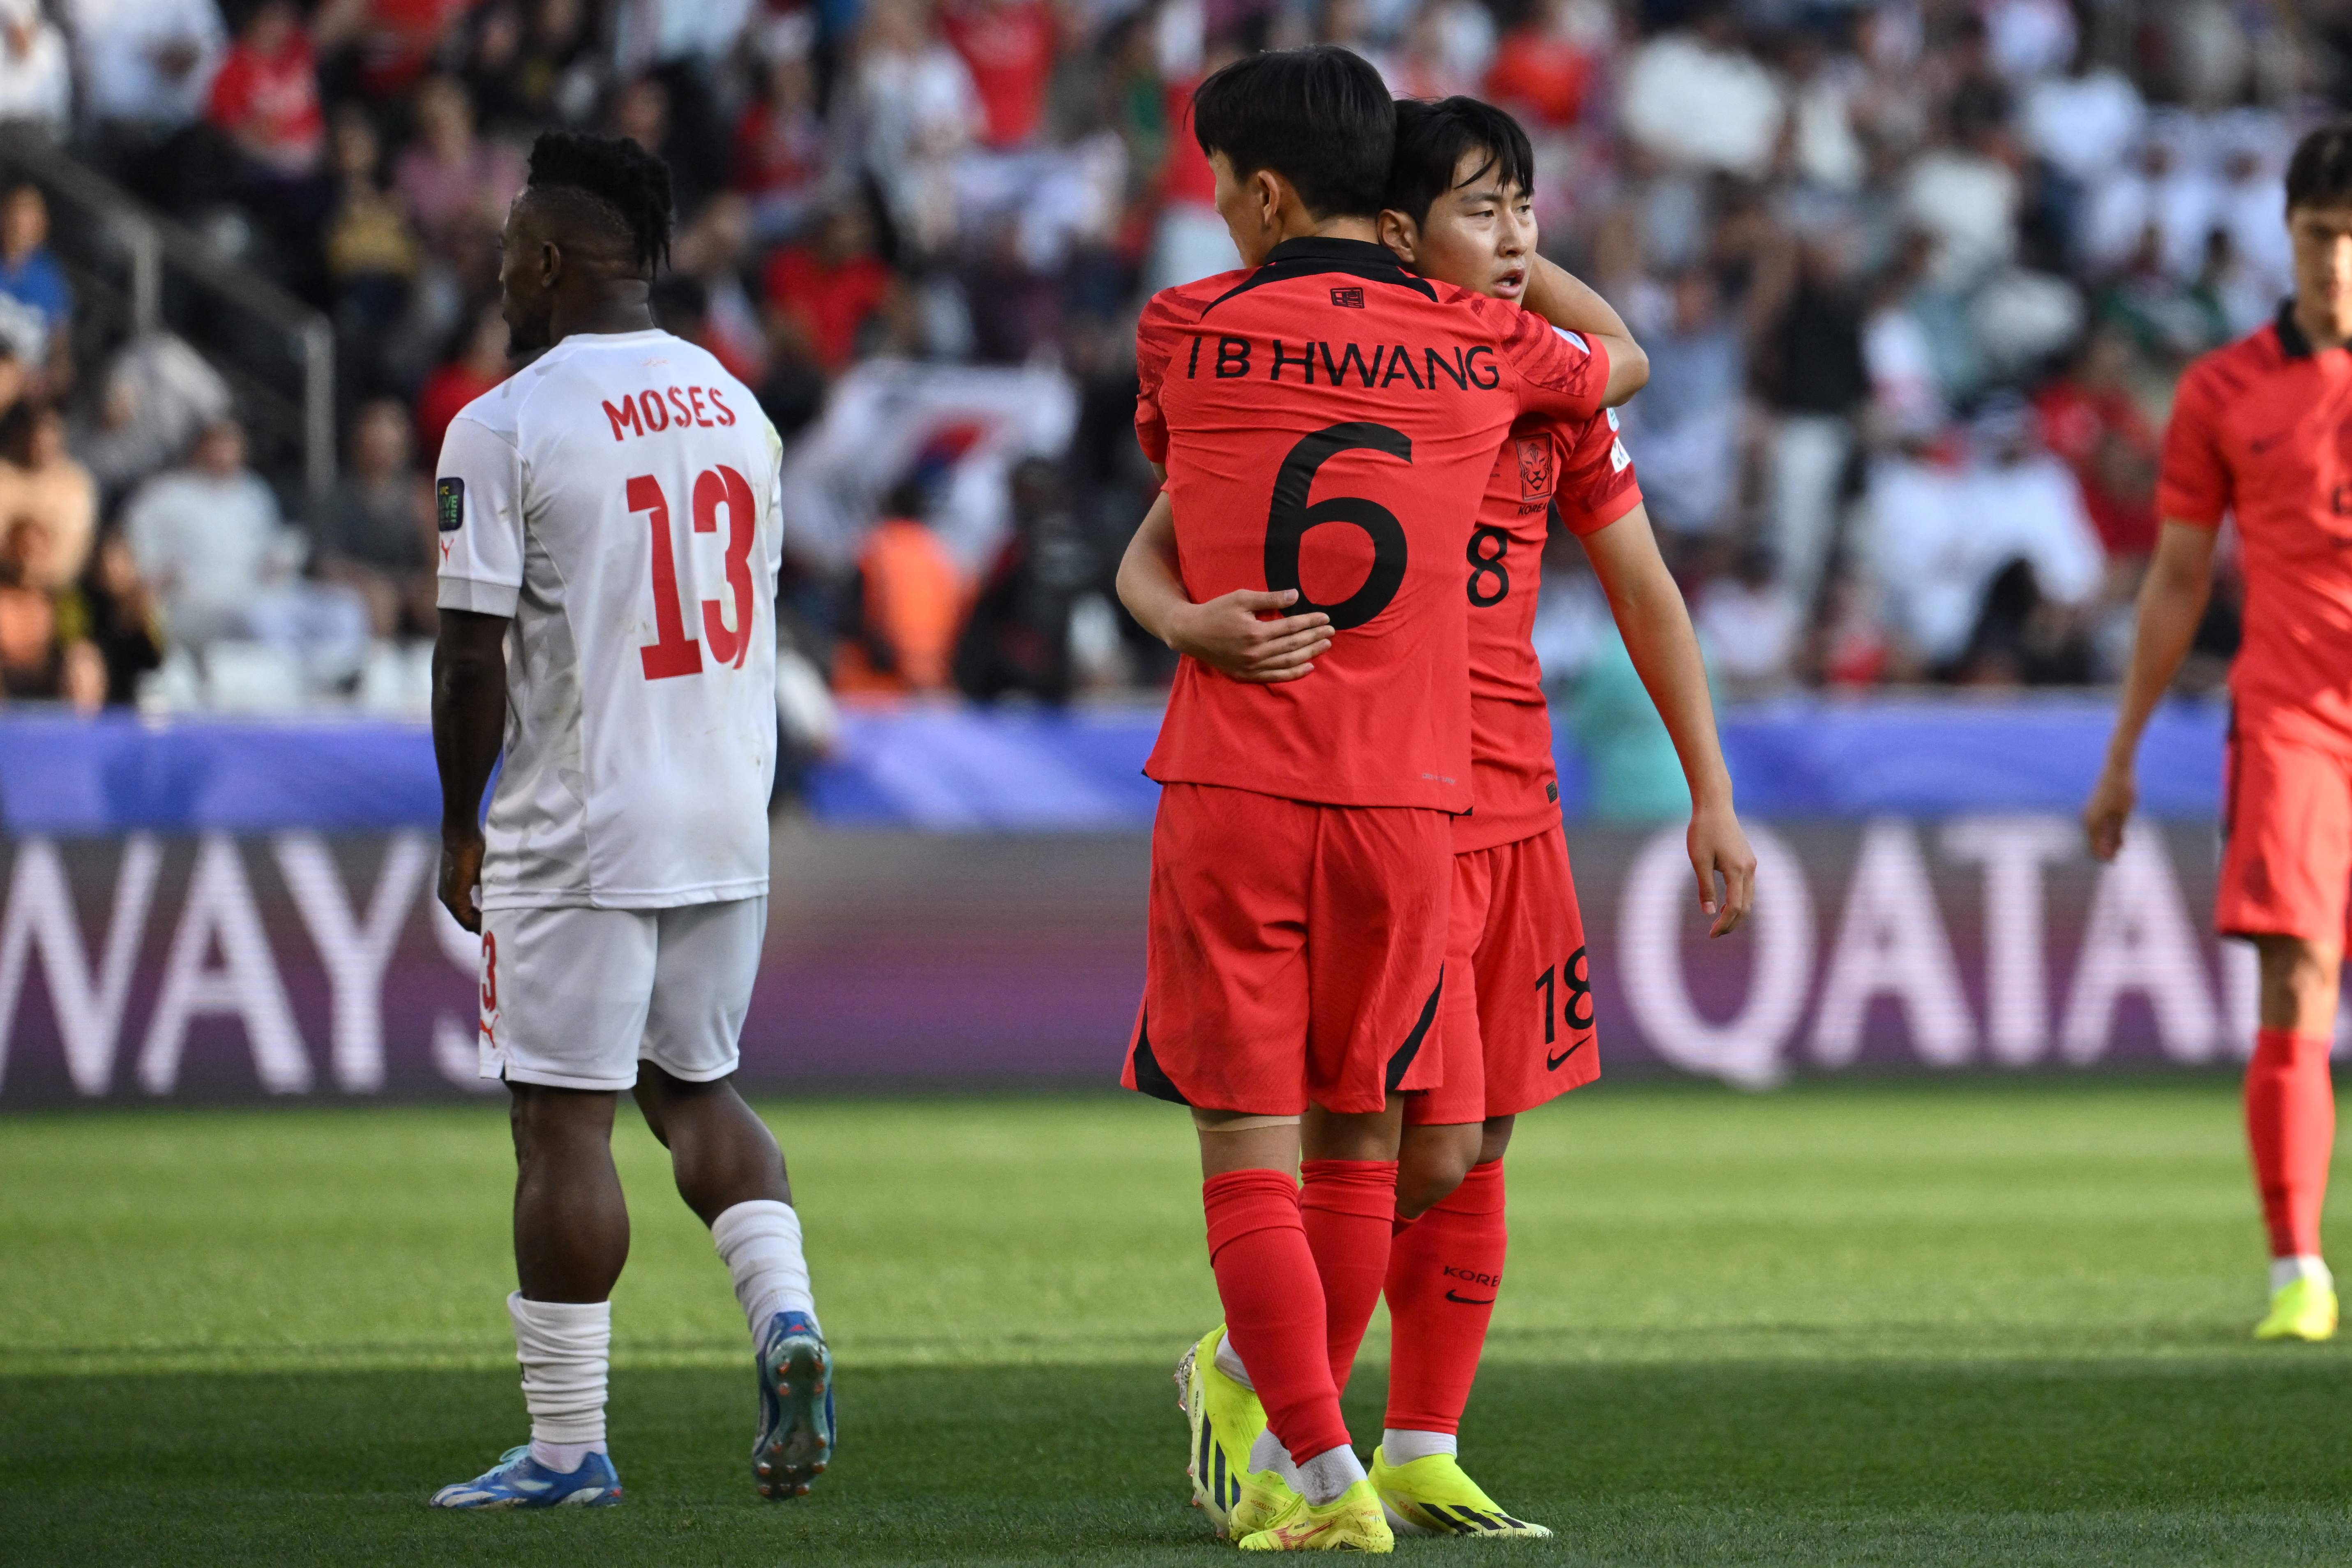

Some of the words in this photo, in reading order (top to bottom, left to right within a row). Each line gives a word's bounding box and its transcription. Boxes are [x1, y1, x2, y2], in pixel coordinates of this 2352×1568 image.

[1271, 339, 1500, 390] HWANG
[602, 386, 736, 441] MOSES
[1264, 422, 1413, 631] 6
[1518, 502, 1547, 516] KOREA
[626, 464, 755, 681] 13
[1466, 526, 1509, 608] 8
[1615, 816, 2352, 1091] QATA
[1535, 945, 1594, 1045] 18
[1443, 1266, 1502, 1287] KORE
